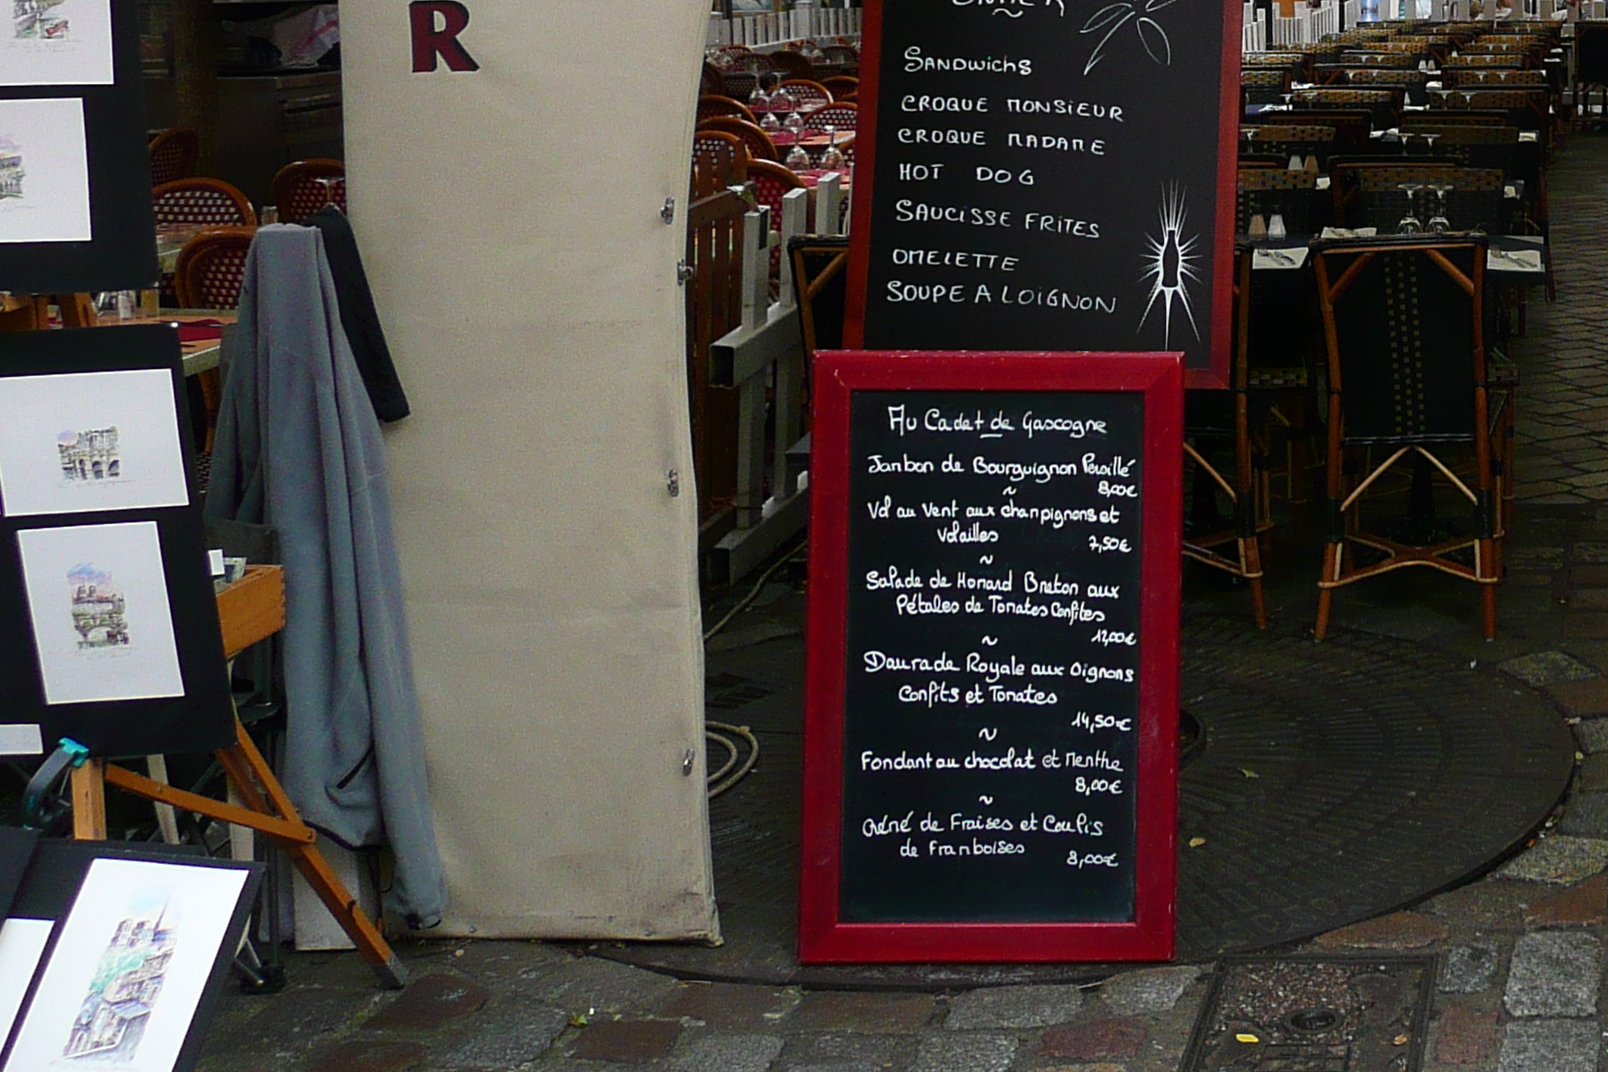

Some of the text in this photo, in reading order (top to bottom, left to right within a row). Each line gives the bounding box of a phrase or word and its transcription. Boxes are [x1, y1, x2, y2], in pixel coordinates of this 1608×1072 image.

[902, 96, 987, 112] CROQUE
[898, 129, 985, 145] CROQUE
[900, 164, 1033, 185] HOT DOG
[887, 281, 963, 302] SOUPE
[888, 404, 1106, 438] Au Cadet de Gascogne
[942, 454, 964, 472] de
[973, 456, 1077, 483] Bourguignon
[897, 507, 916, 518] au
[922, 500, 959, 517] Vent
[966, 506, 995, 517] aux
[1099, 505, 1120, 523] et
[930, 569, 952, 588] de
[1024, 571, 1078, 595] Breton
[1088, 585, 1119, 598] aux
[896, 593, 959, 615] Pétales
[965, 596, 984, 613] de
[864, 651, 1134, 683] Daurade Royale aux Oignons
[965, 684, 984, 704] et
[862, 751, 932, 770] Fondant
[936, 758, 960, 768] au
[1042, 749, 1061, 768] et
[920, 812, 944, 831] de
[951, 813, 1013, 830] Fraises
[1020, 813, 1038, 831] et
[900, 838, 918, 857] de
